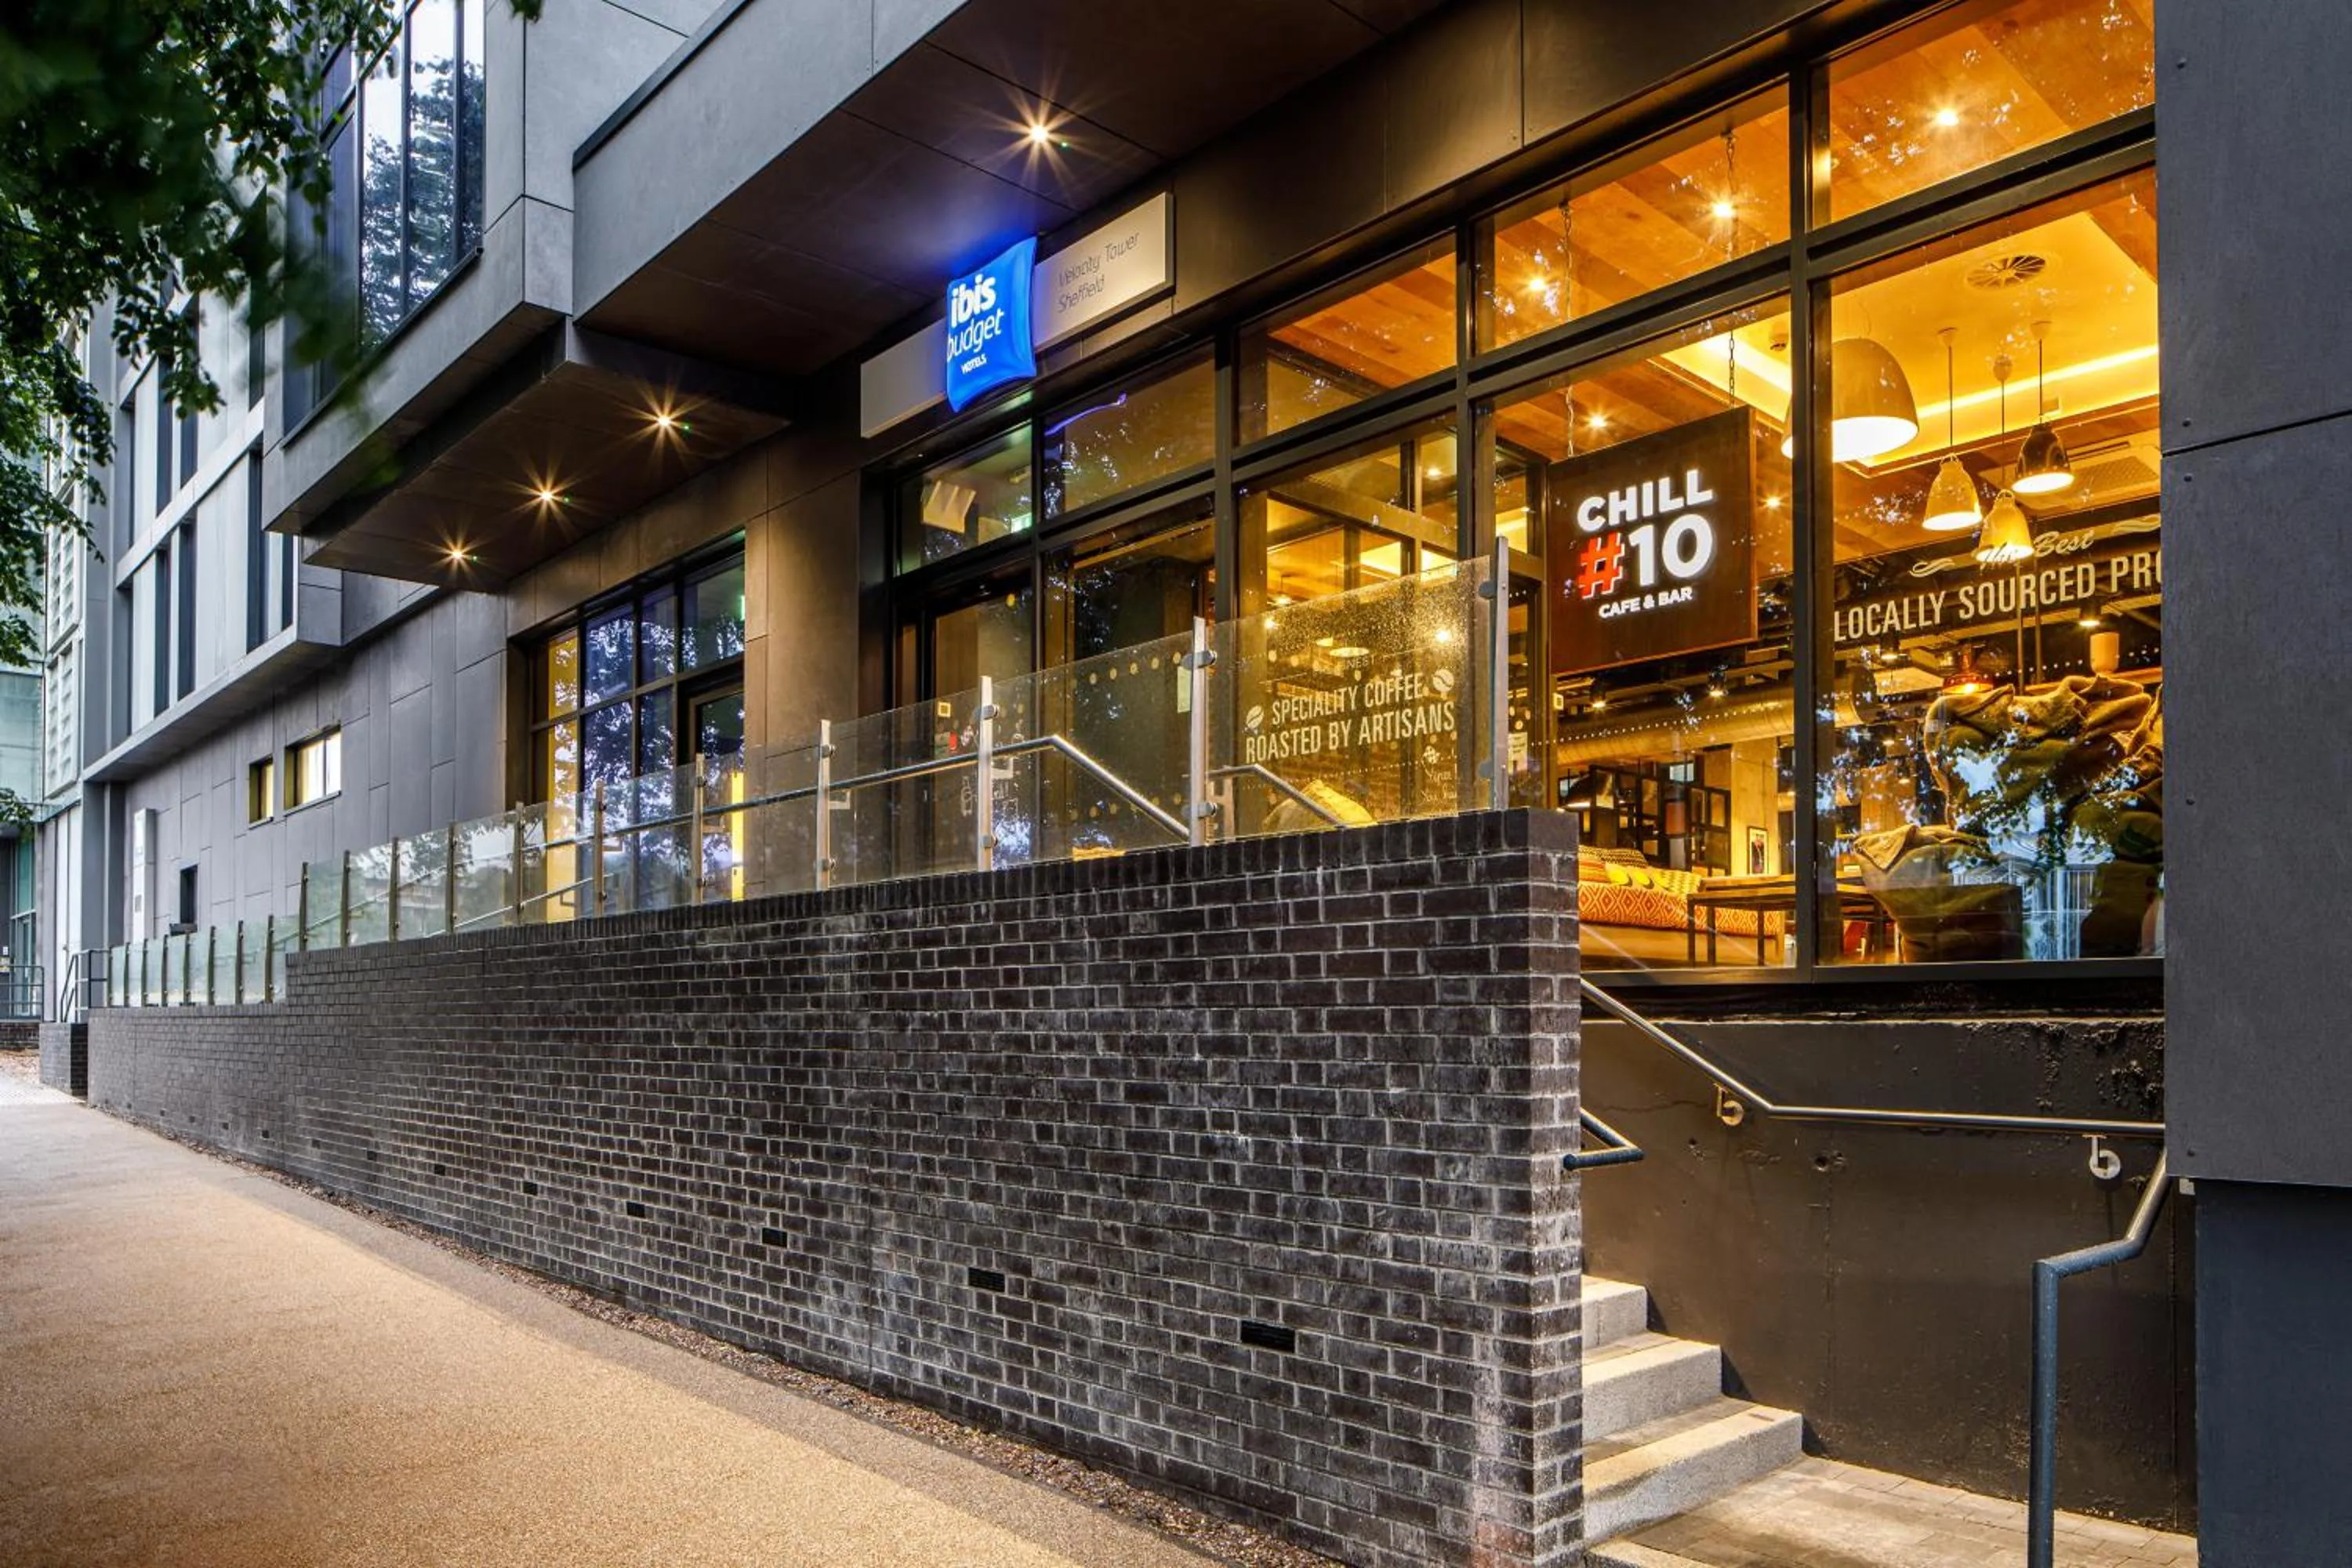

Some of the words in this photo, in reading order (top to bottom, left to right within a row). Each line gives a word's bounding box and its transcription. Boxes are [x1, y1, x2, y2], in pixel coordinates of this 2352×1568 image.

[1104, 233, 1140, 263] Tower
[951, 274, 997, 328] ibis
[1057, 274, 1105, 313] Sheffield
[947, 308, 1004, 362] budget
[960, 354, 987, 375] HOTELS
[1577, 469, 1713, 532] CHILL
[1577, 514, 1712, 599] #10
[2033, 529, 2094, 557] Best
[1599, 597, 1640, 618] CAFE
[1643, 594, 1654, 608] &
[1658, 586, 1693, 605] BAR
[1835, 590, 1946, 641] LOCALLY
[1960, 563, 2096, 619] SOURCED
[1272, 685, 1359, 726] SPECIALITY
[1365, 672, 1424, 708] COFFEE
[1246, 725, 1321, 764] ROASTED
[1329, 719, 1352, 750] BY
[1359, 701, 1454, 746] ARTISANS
